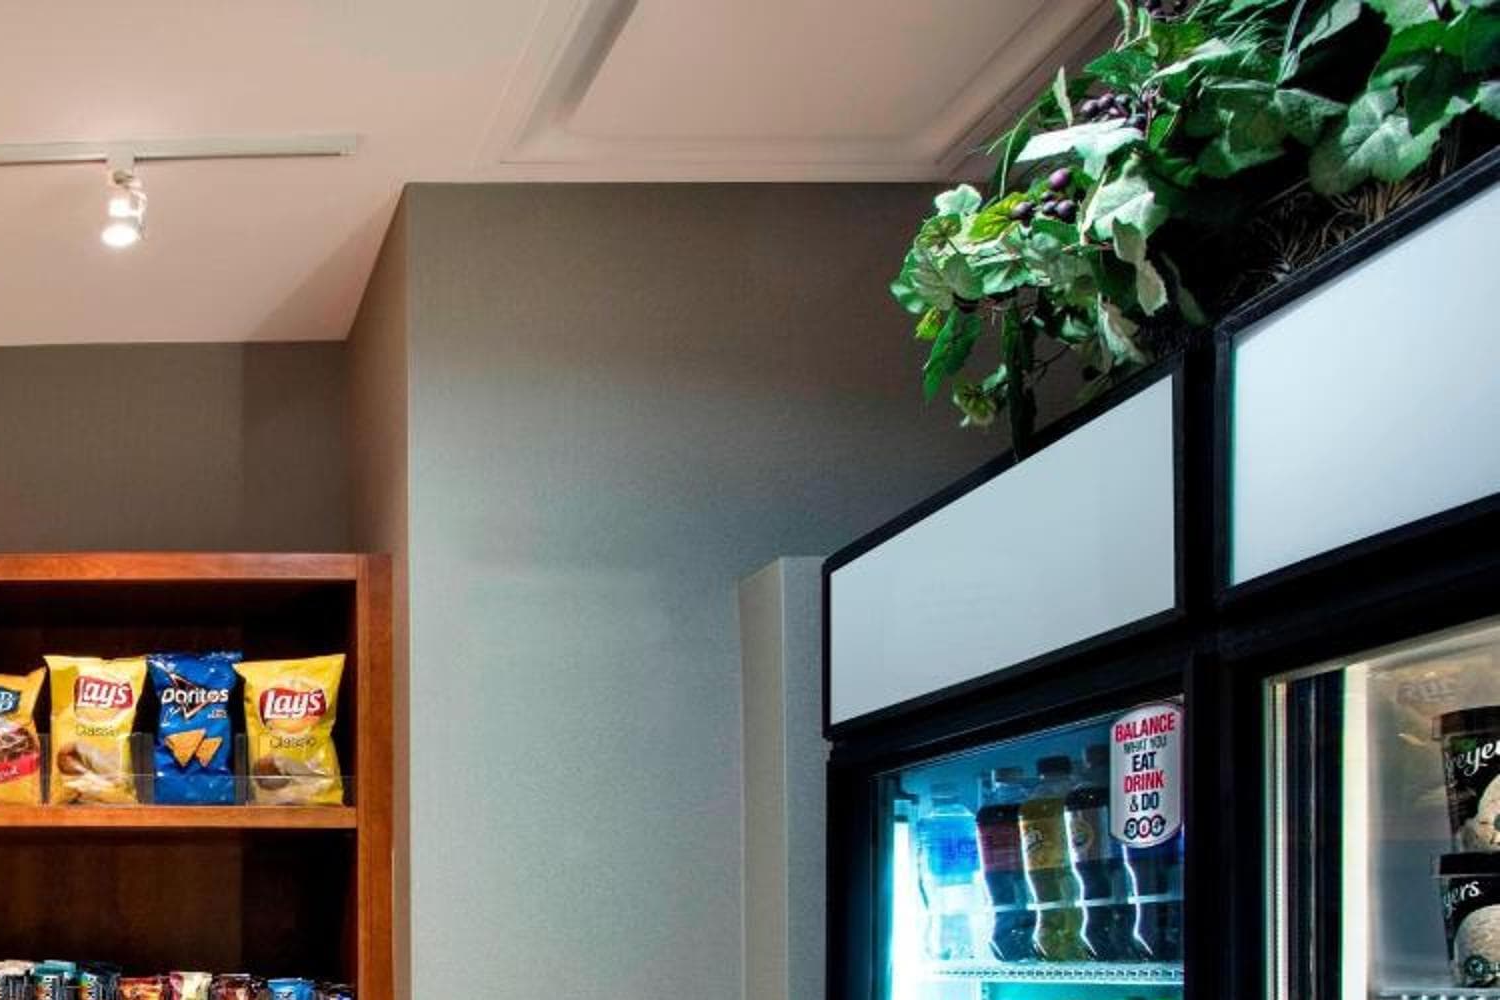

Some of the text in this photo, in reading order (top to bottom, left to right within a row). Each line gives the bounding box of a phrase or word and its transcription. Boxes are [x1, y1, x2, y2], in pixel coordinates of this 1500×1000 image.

[77, 677, 131, 710] Lay's
[161, 687, 229, 705] Doritos
[264, 687, 325, 720] Lay's
[1115, 712, 1175, 743] BALANCE
[1132, 751, 1157, 772] EAT
[1123, 770, 1165, 793] DRINK
[1129, 792, 1160, 812] & DO
